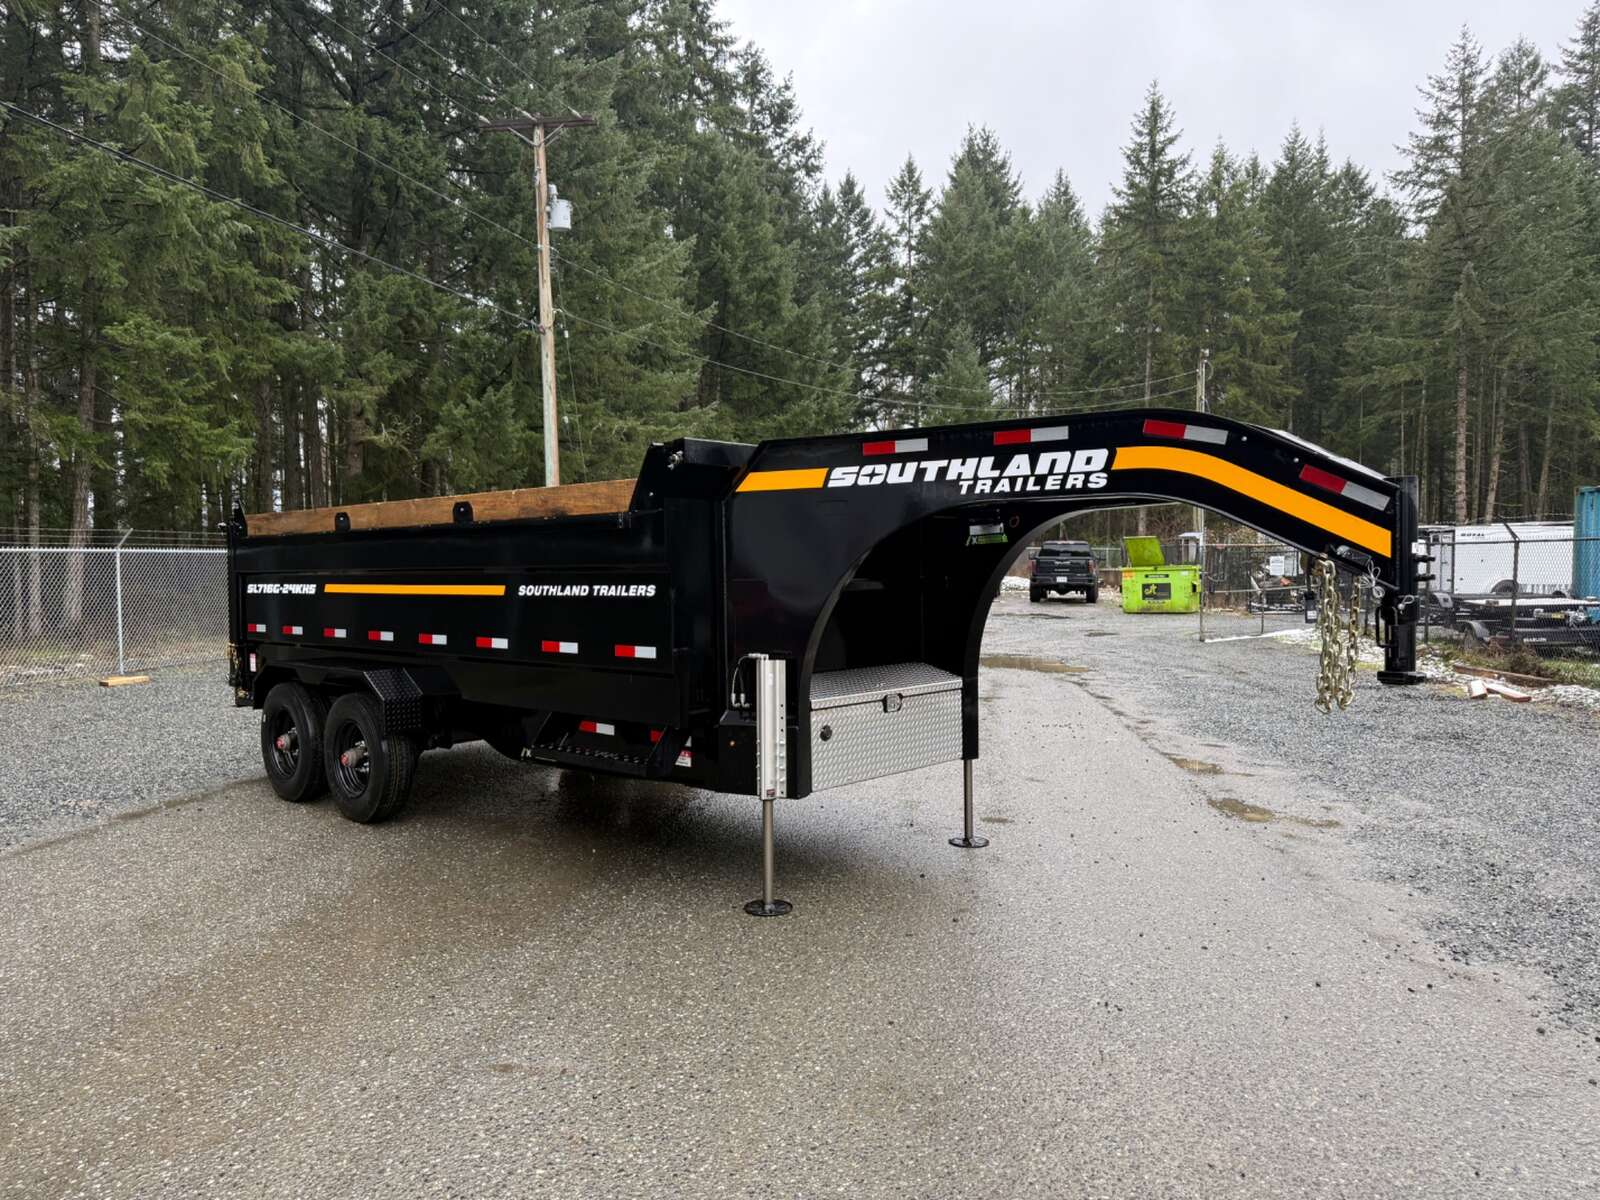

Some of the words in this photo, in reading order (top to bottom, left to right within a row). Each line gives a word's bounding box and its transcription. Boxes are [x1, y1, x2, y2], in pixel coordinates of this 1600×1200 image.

[827, 448, 1109, 487] SOUTHLAND
[959, 472, 1108, 495] TRAILERS
[518, 585, 589, 596] SOUTHLAND
[593, 585, 656, 597] TRAILERS
